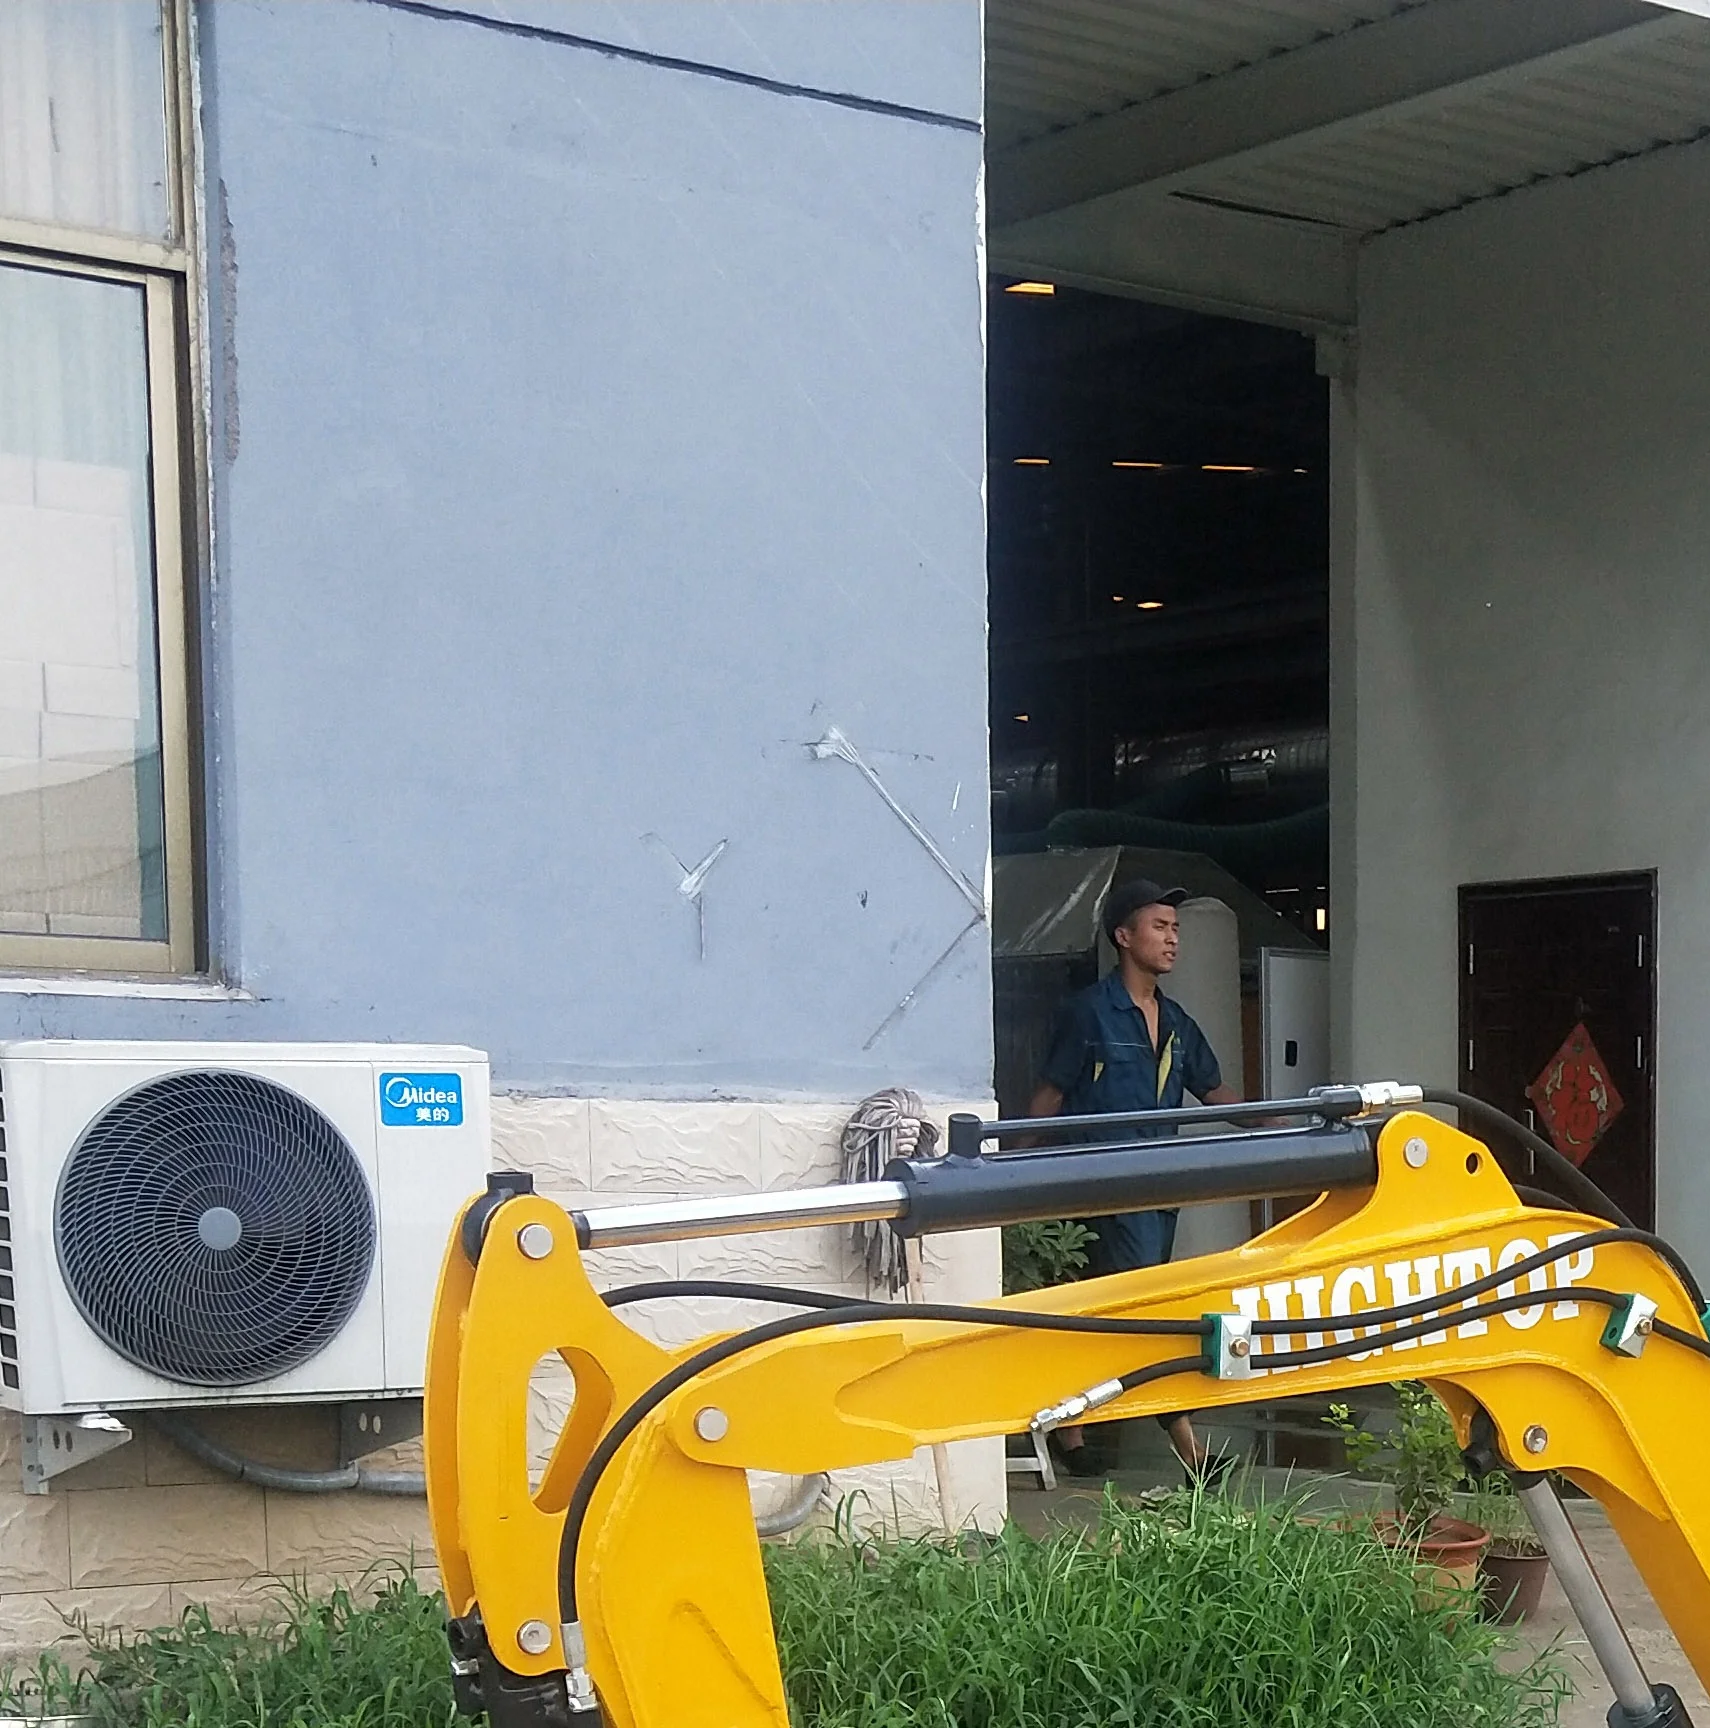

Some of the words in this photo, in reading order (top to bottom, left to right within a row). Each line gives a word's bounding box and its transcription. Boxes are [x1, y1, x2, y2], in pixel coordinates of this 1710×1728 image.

[394, 1085, 458, 1107] Midea
[415, 1107, 450, 1122] 美的
[1232, 1231, 1594, 1377] HIGHTOP
